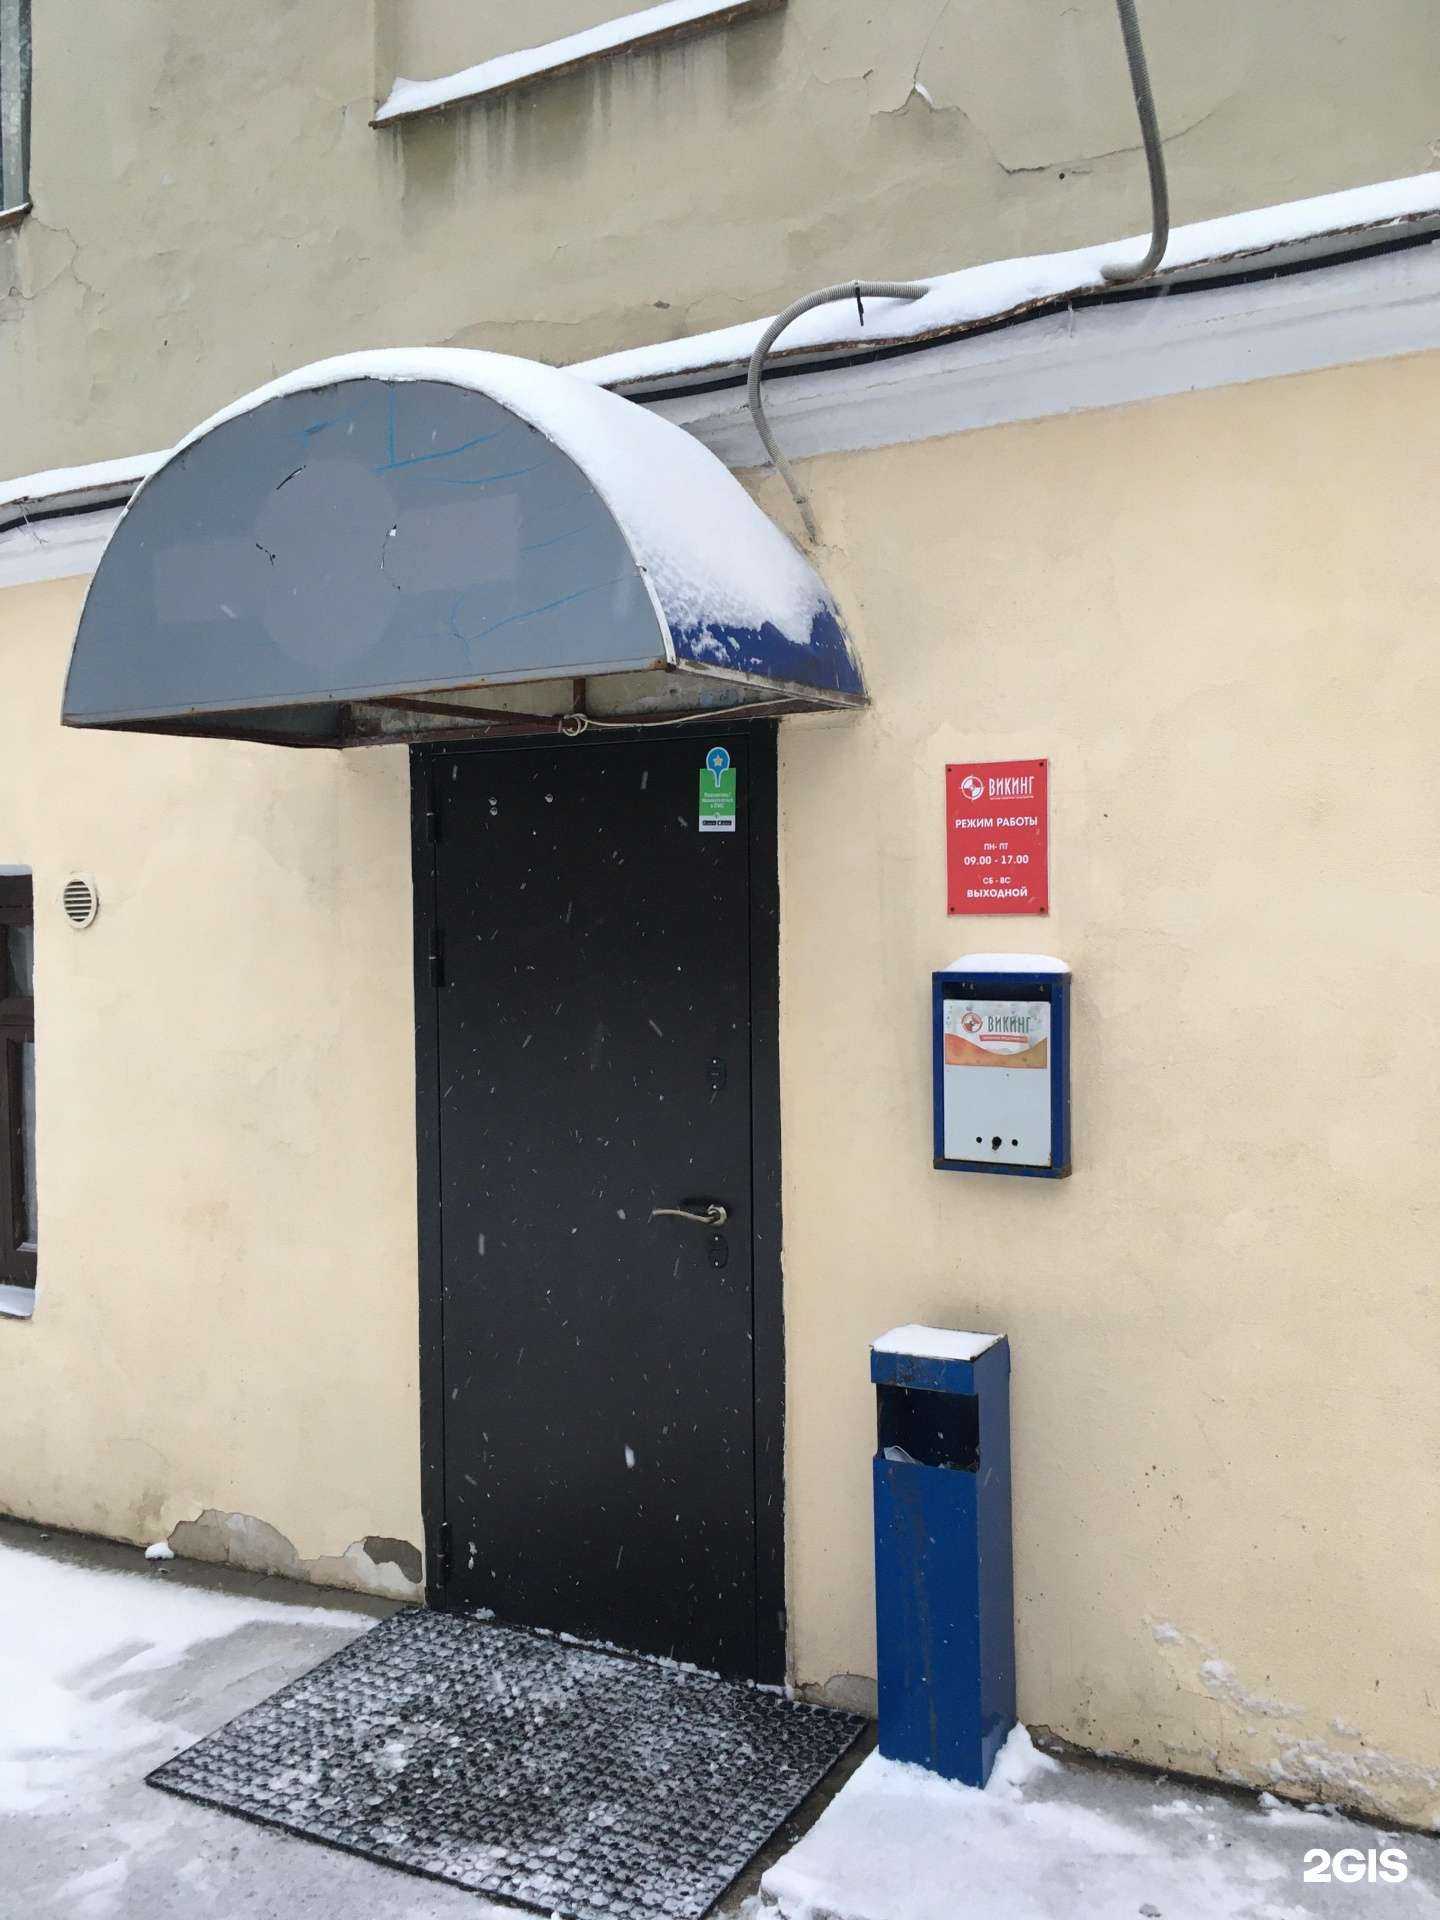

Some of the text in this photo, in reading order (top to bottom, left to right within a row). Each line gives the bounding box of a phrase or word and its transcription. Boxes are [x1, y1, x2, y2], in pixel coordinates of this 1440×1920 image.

[989, 776, 1035, 796] ВИКИНГ
[955, 816, 1038, 829] РЕЖИМ РАБОТЫ
[963, 855, 992, 865] 09.00
[1001, 855, 1029, 865] 17.00
[966, 886, 1028, 898] ВЫХОДНОЙ
[988, 1015, 1031, 1033] ВИКИНГ
